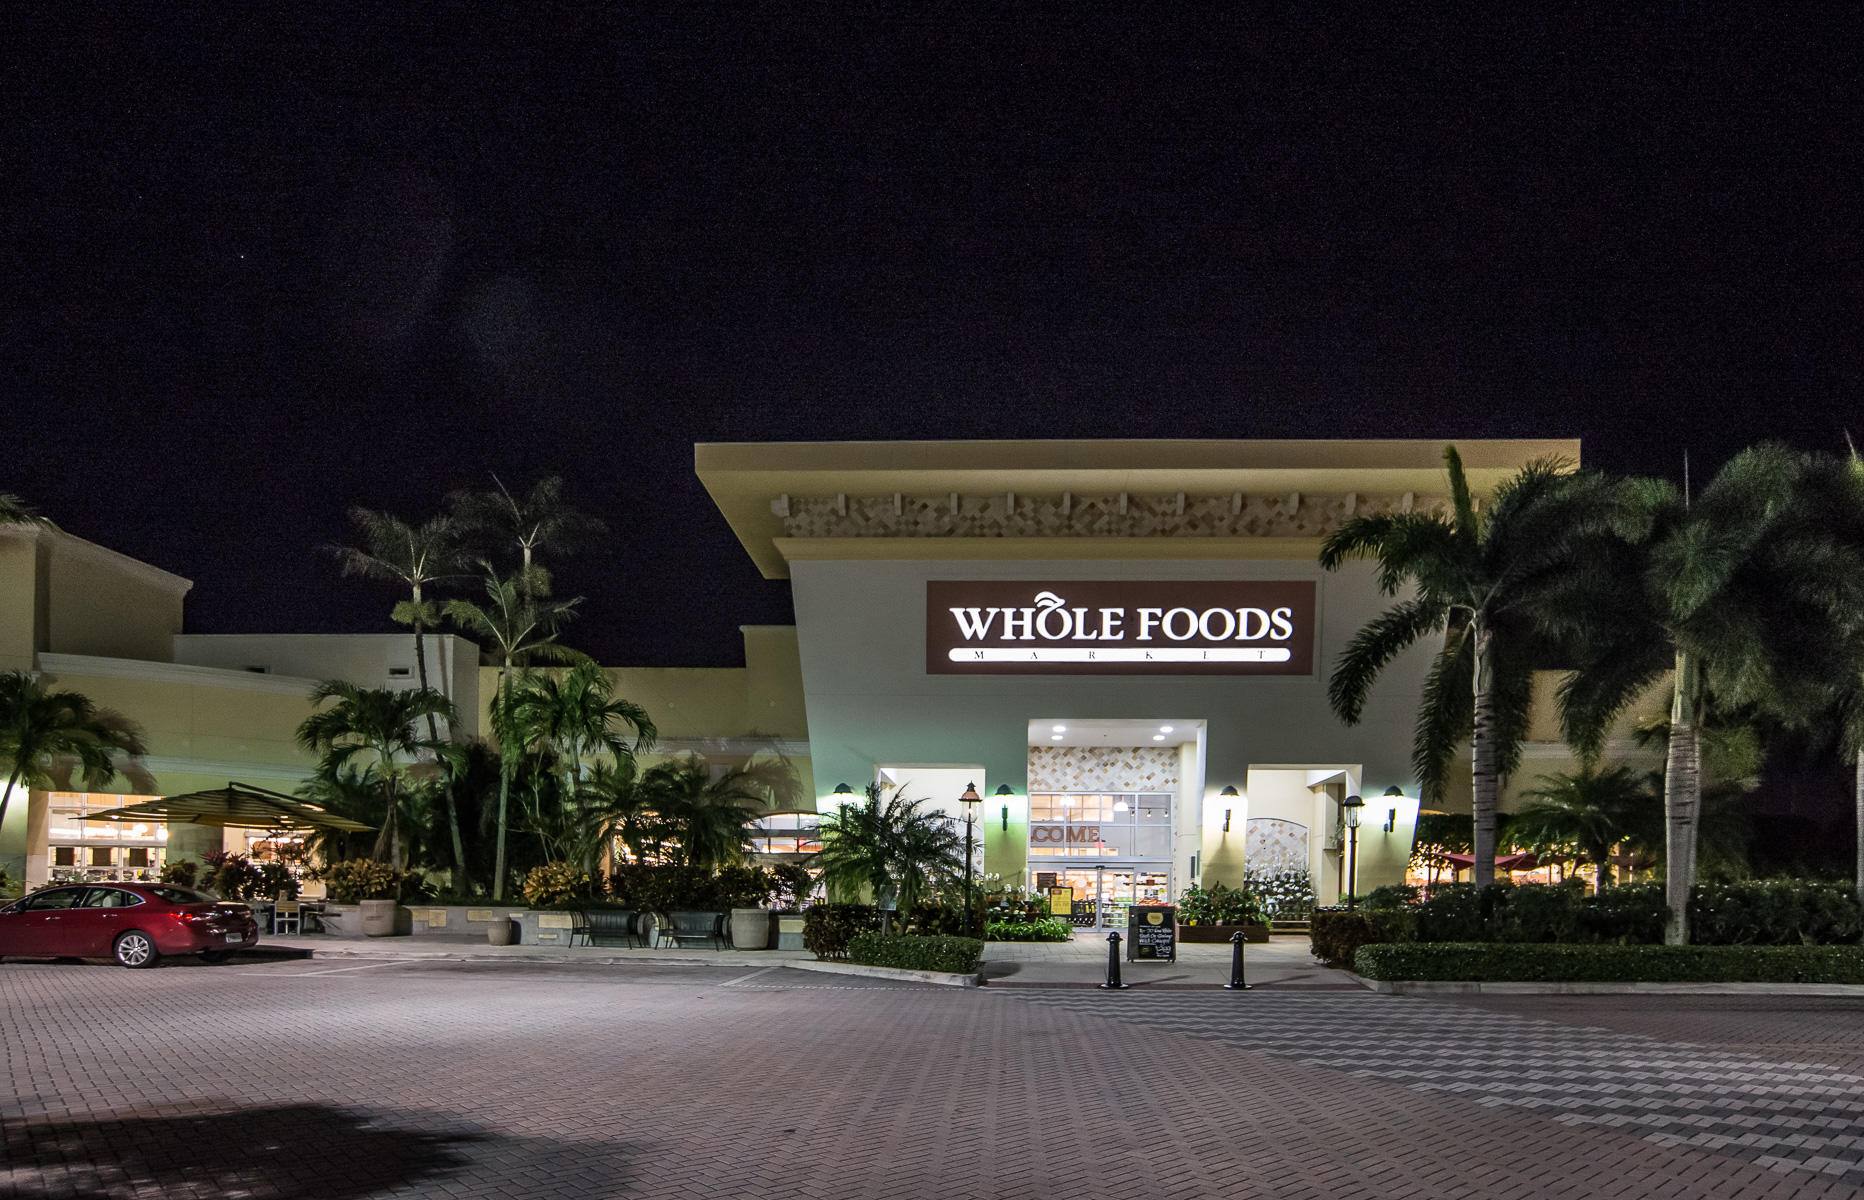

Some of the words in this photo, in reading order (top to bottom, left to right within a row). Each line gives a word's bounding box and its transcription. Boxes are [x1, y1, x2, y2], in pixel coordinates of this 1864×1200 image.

[948, 591, 1125, 641] WHOLE
[1136, 607, 1293, 641] FOODS
[973, 650, 1268, 660] MARKET
[1030, 825, 1101, 843] COME
